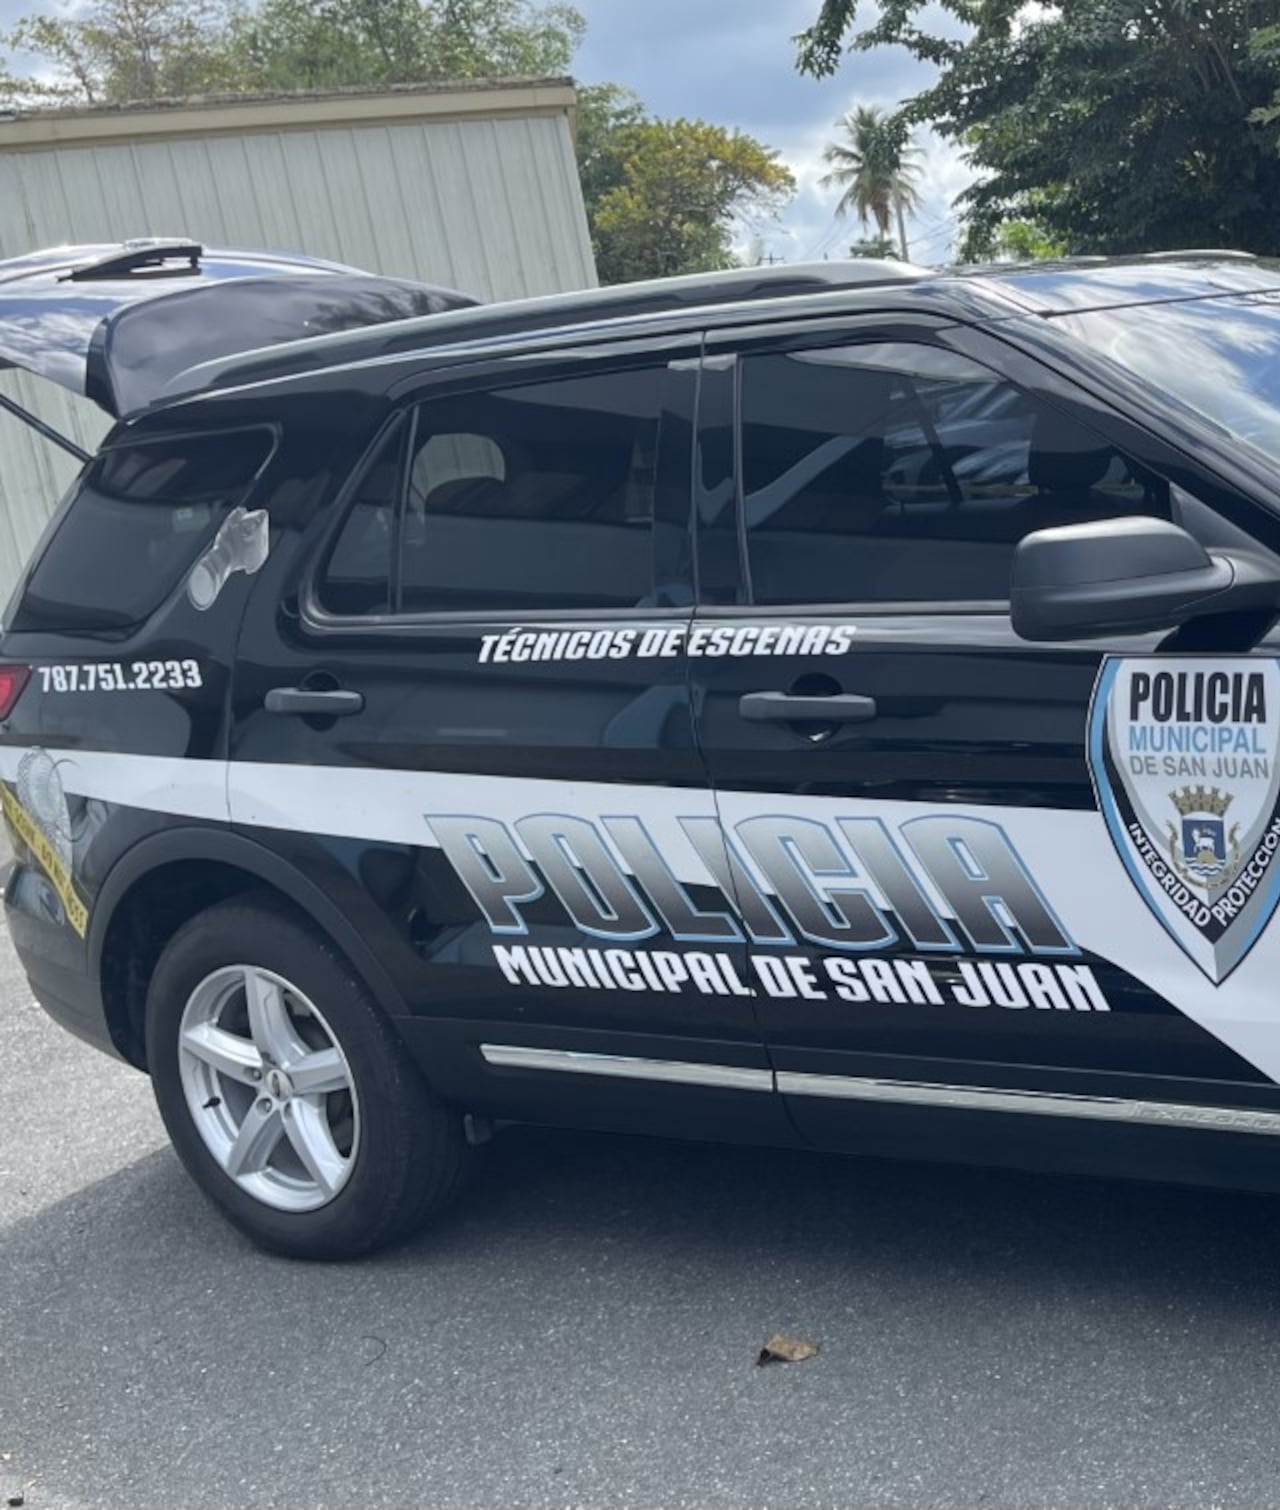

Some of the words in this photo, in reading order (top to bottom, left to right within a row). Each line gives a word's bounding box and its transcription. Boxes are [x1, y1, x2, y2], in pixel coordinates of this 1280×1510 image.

[479, 628, 635, 662] TÉCNICOS
[636, 630, 686, 657] DE
[686, 627, 853, 657] ESCENAS
[39, 659, 203, 693] 787.751.2233
[1129, 671, 1267, 724] POLICIA
[1128, 726, 1267, 755] MUNICIPAL
[1129, 755, 1159, 776] DE
[1164, 757, 1207, 777] SAN
[1212, 758, 1269, 780] JUAN
[423, 813, 1082, 955] POLICIA
[1129, 823, 1212, 928] INTEGRIDAD
[492, 945, 752, 999] MUNICIPAL
[749, 956, 829, 1000] DE
[833, 957, 945, 1006] SAN
[950, 963, 1111, 1012] JUAN
